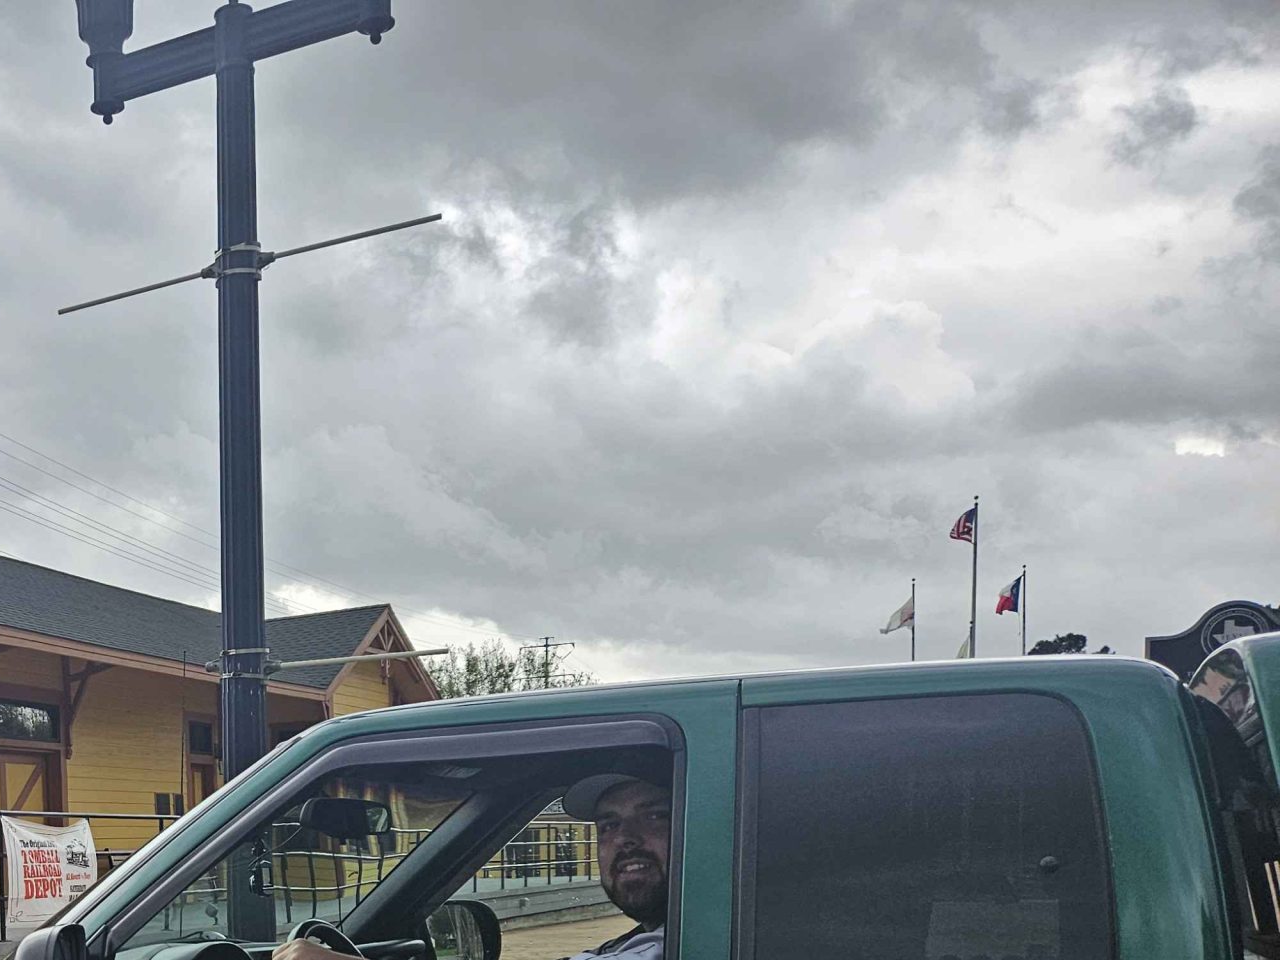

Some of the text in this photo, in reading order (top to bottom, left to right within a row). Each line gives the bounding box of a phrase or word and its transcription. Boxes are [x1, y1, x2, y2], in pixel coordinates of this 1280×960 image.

[21, 849, 60, 864] TOMBALL
[23, 864, 62, 878] RAILROAD
[24, 878, 63, 900] DEPOT
